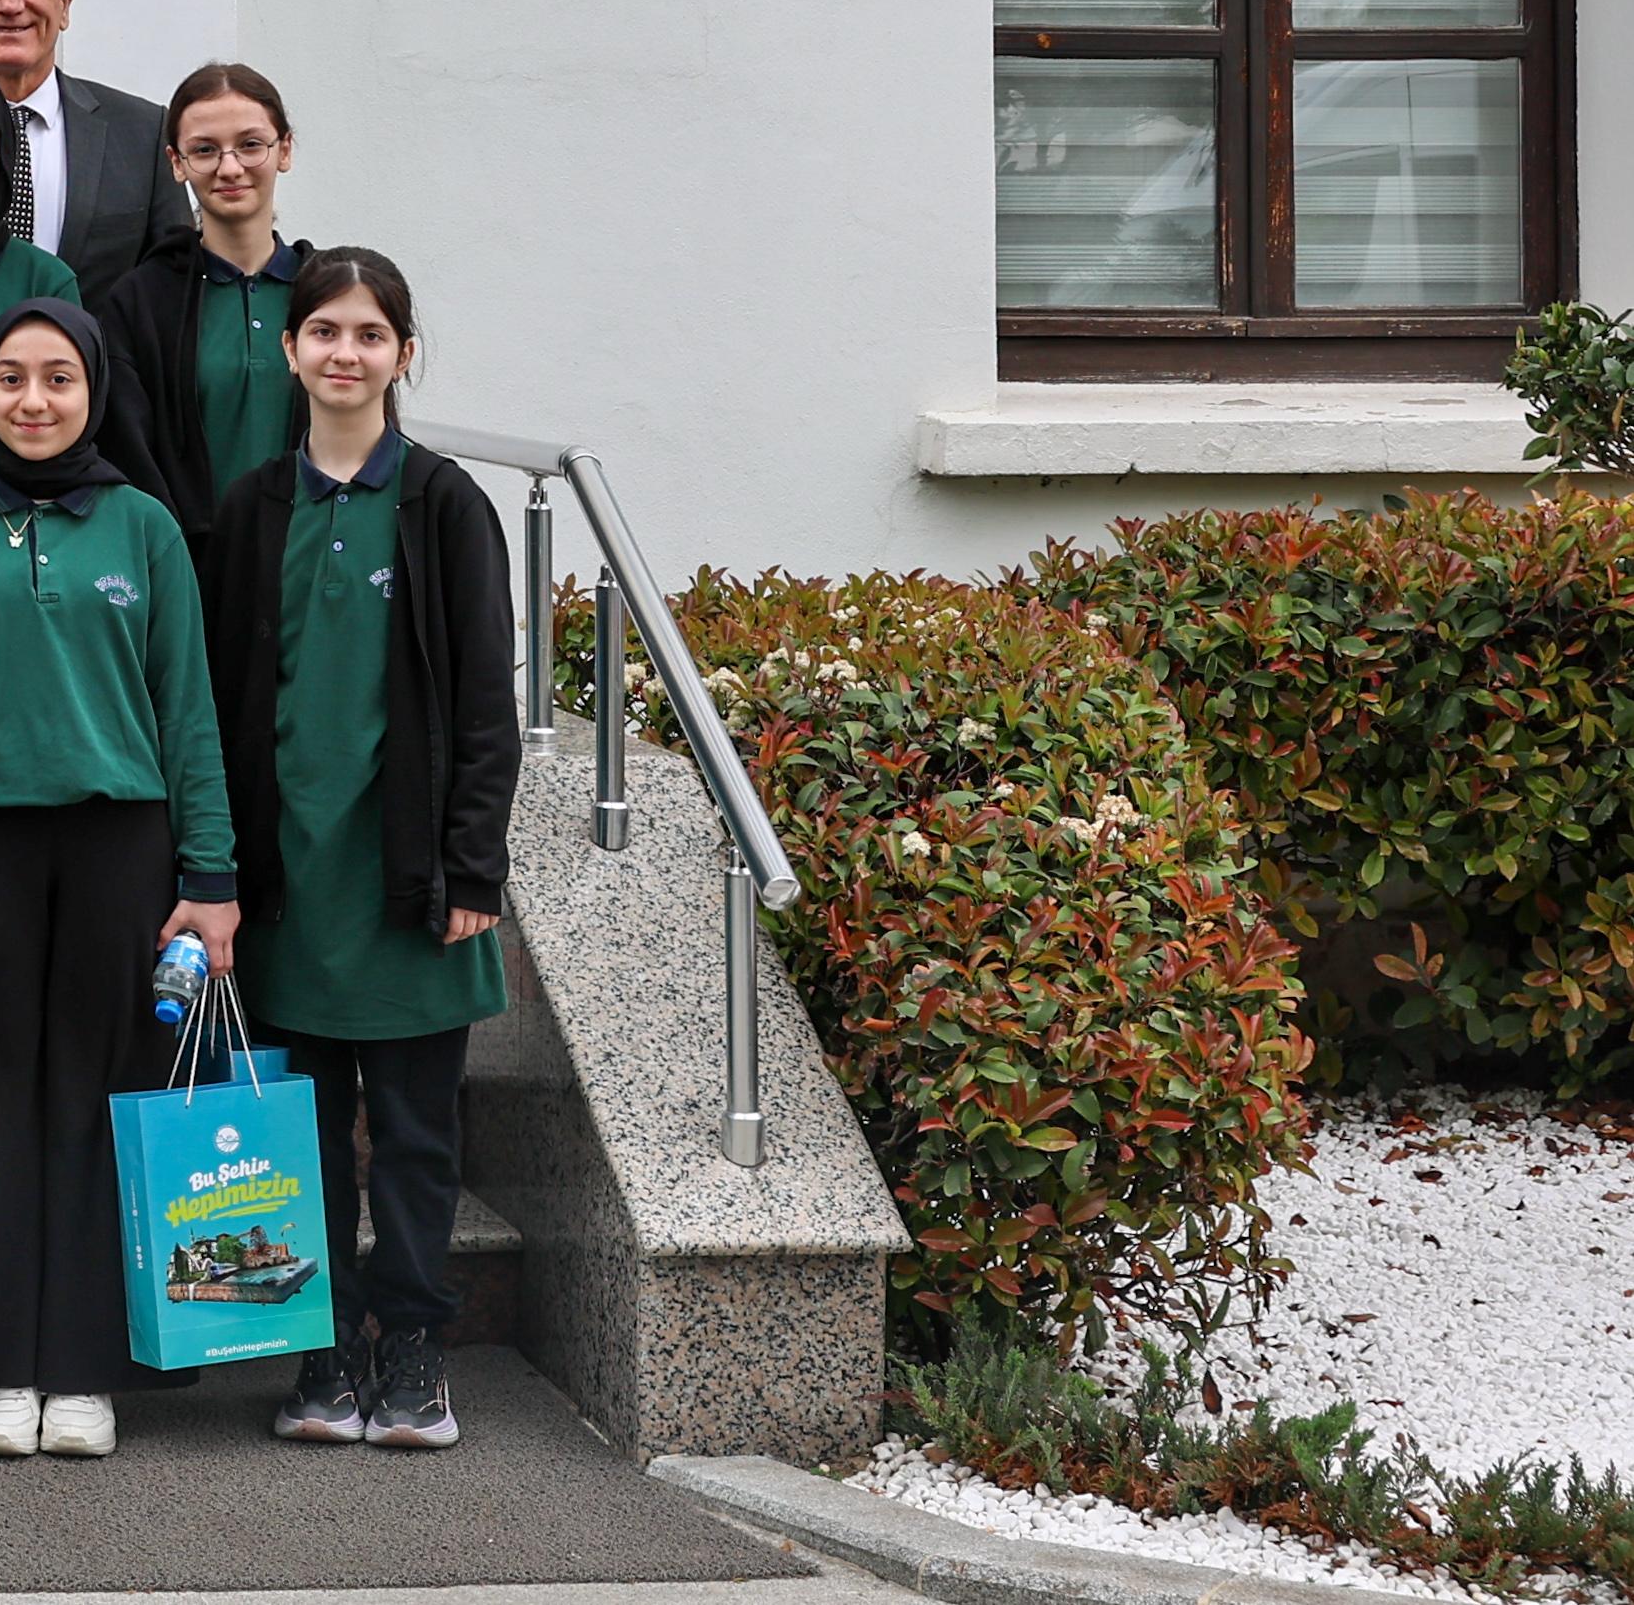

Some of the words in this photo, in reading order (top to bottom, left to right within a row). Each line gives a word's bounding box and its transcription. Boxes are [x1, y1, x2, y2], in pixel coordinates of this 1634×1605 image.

[189, 1172, 216, 1192] Bu
[217, 1157, 271, 1188] Şehir
[165, 1172, 301, 1228] Hepimizin
[205, 1338, 288, 1357] #BuŞehirHepimizin
